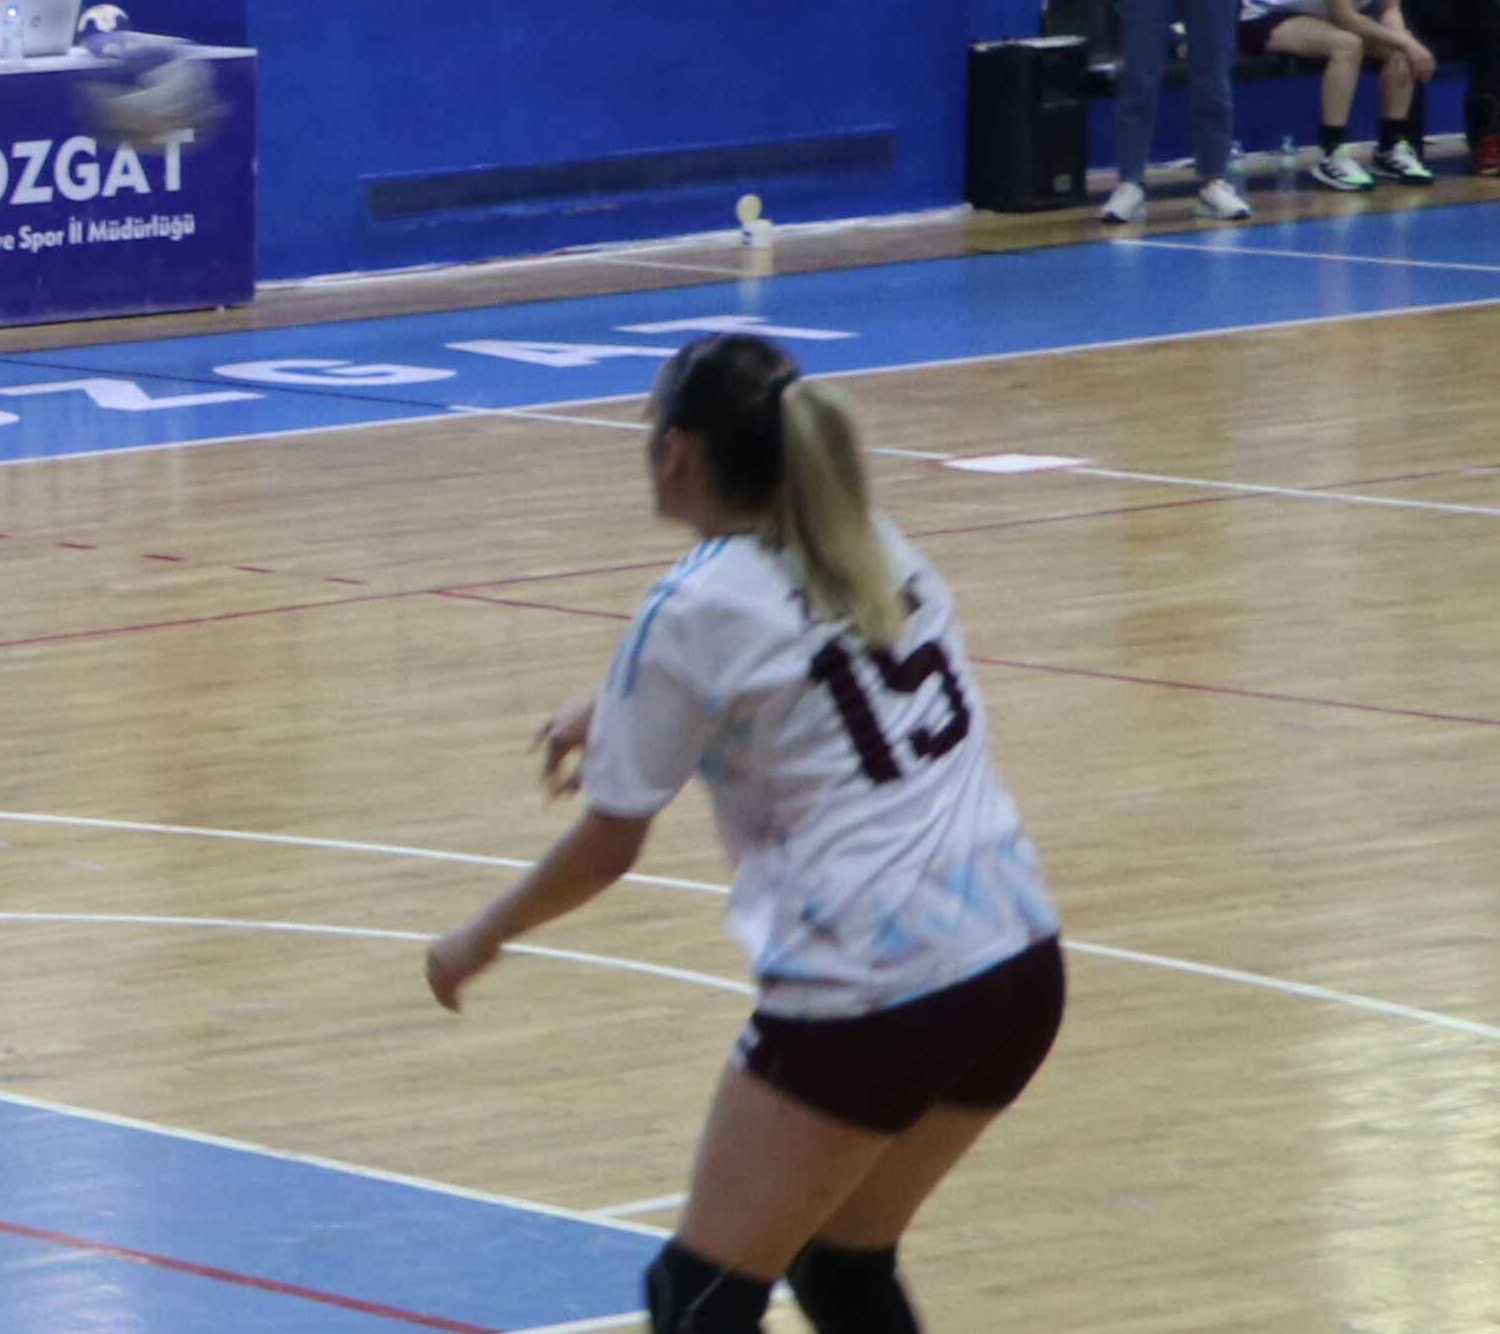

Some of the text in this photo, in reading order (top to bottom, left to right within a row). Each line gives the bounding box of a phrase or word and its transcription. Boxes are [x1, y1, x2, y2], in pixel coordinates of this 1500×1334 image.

[18, 225, 65, 254] Spor
[67, 217, 83, 244] İl
[86, 214, 196, 242] Müdürlüğü
